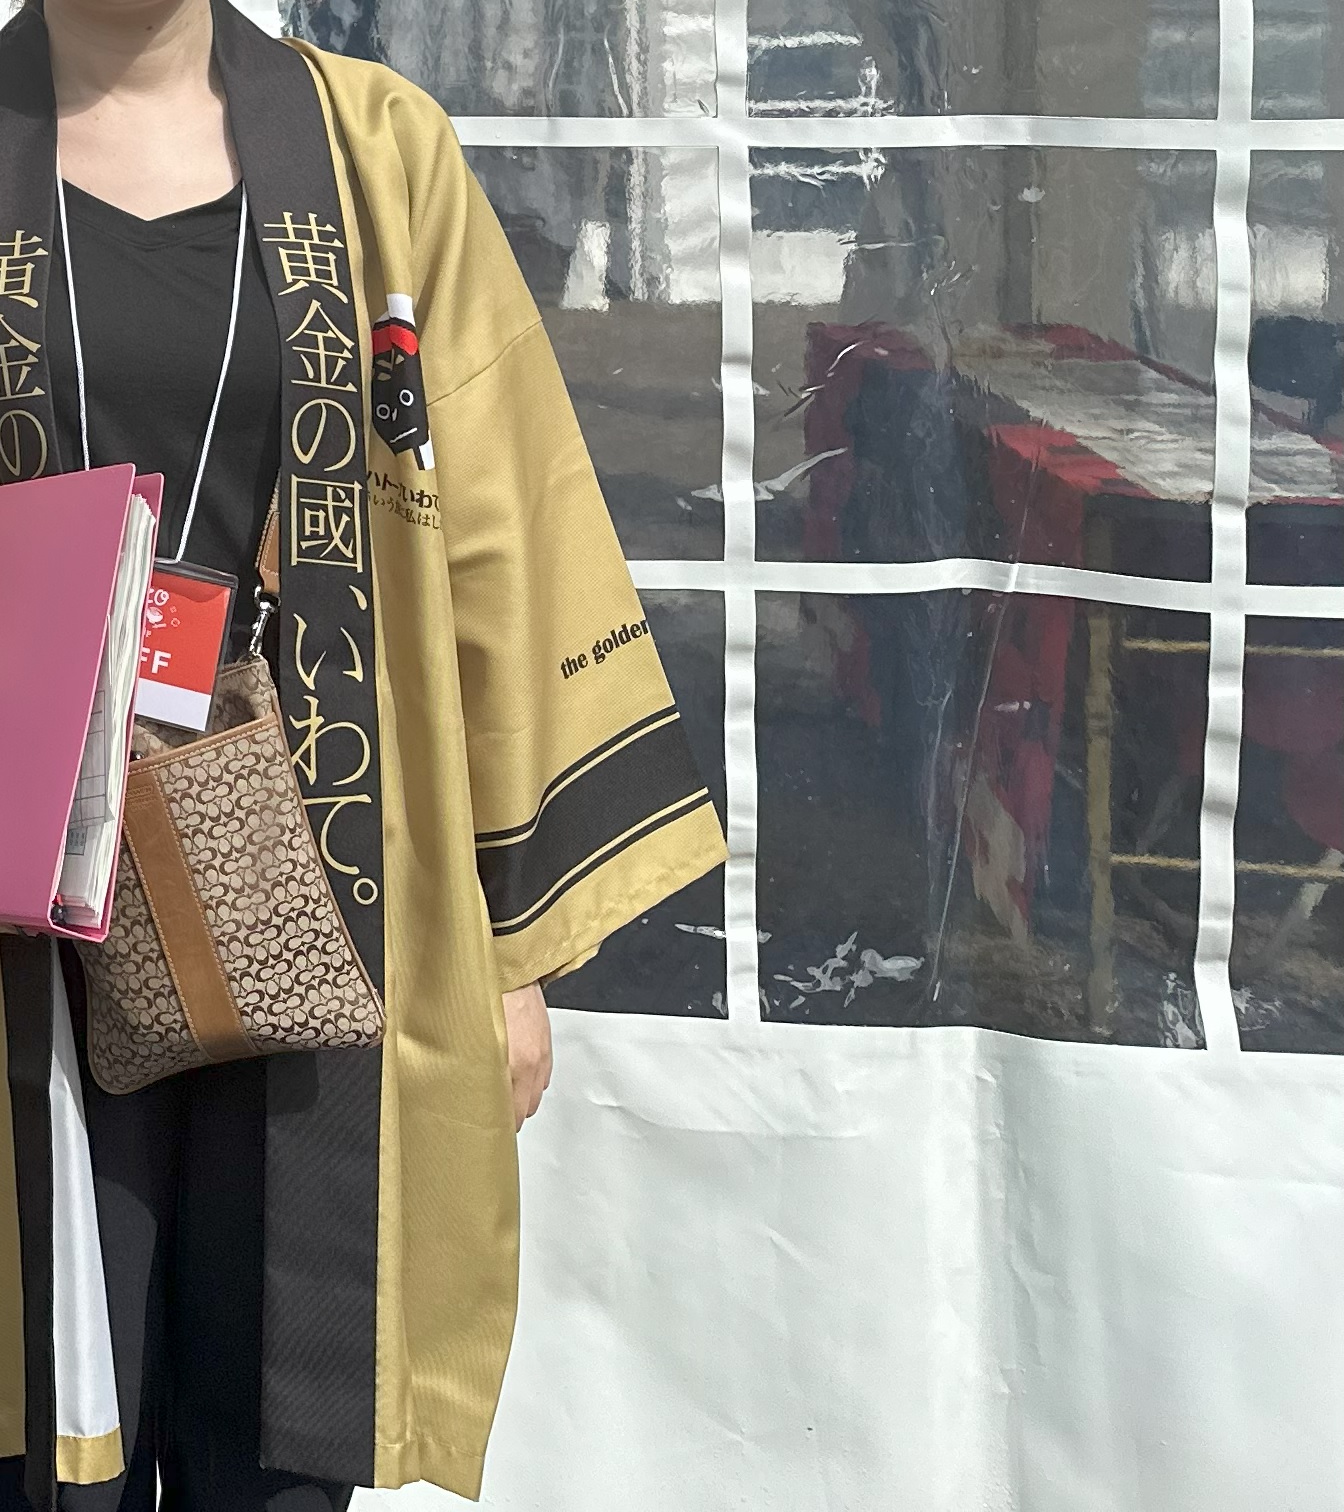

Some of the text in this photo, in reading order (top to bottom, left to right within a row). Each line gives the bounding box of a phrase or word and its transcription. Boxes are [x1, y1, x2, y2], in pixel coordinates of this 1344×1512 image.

[262, 212, 378, 906] 黄金の國、いわて。
[560, 656, 589, 680] the
